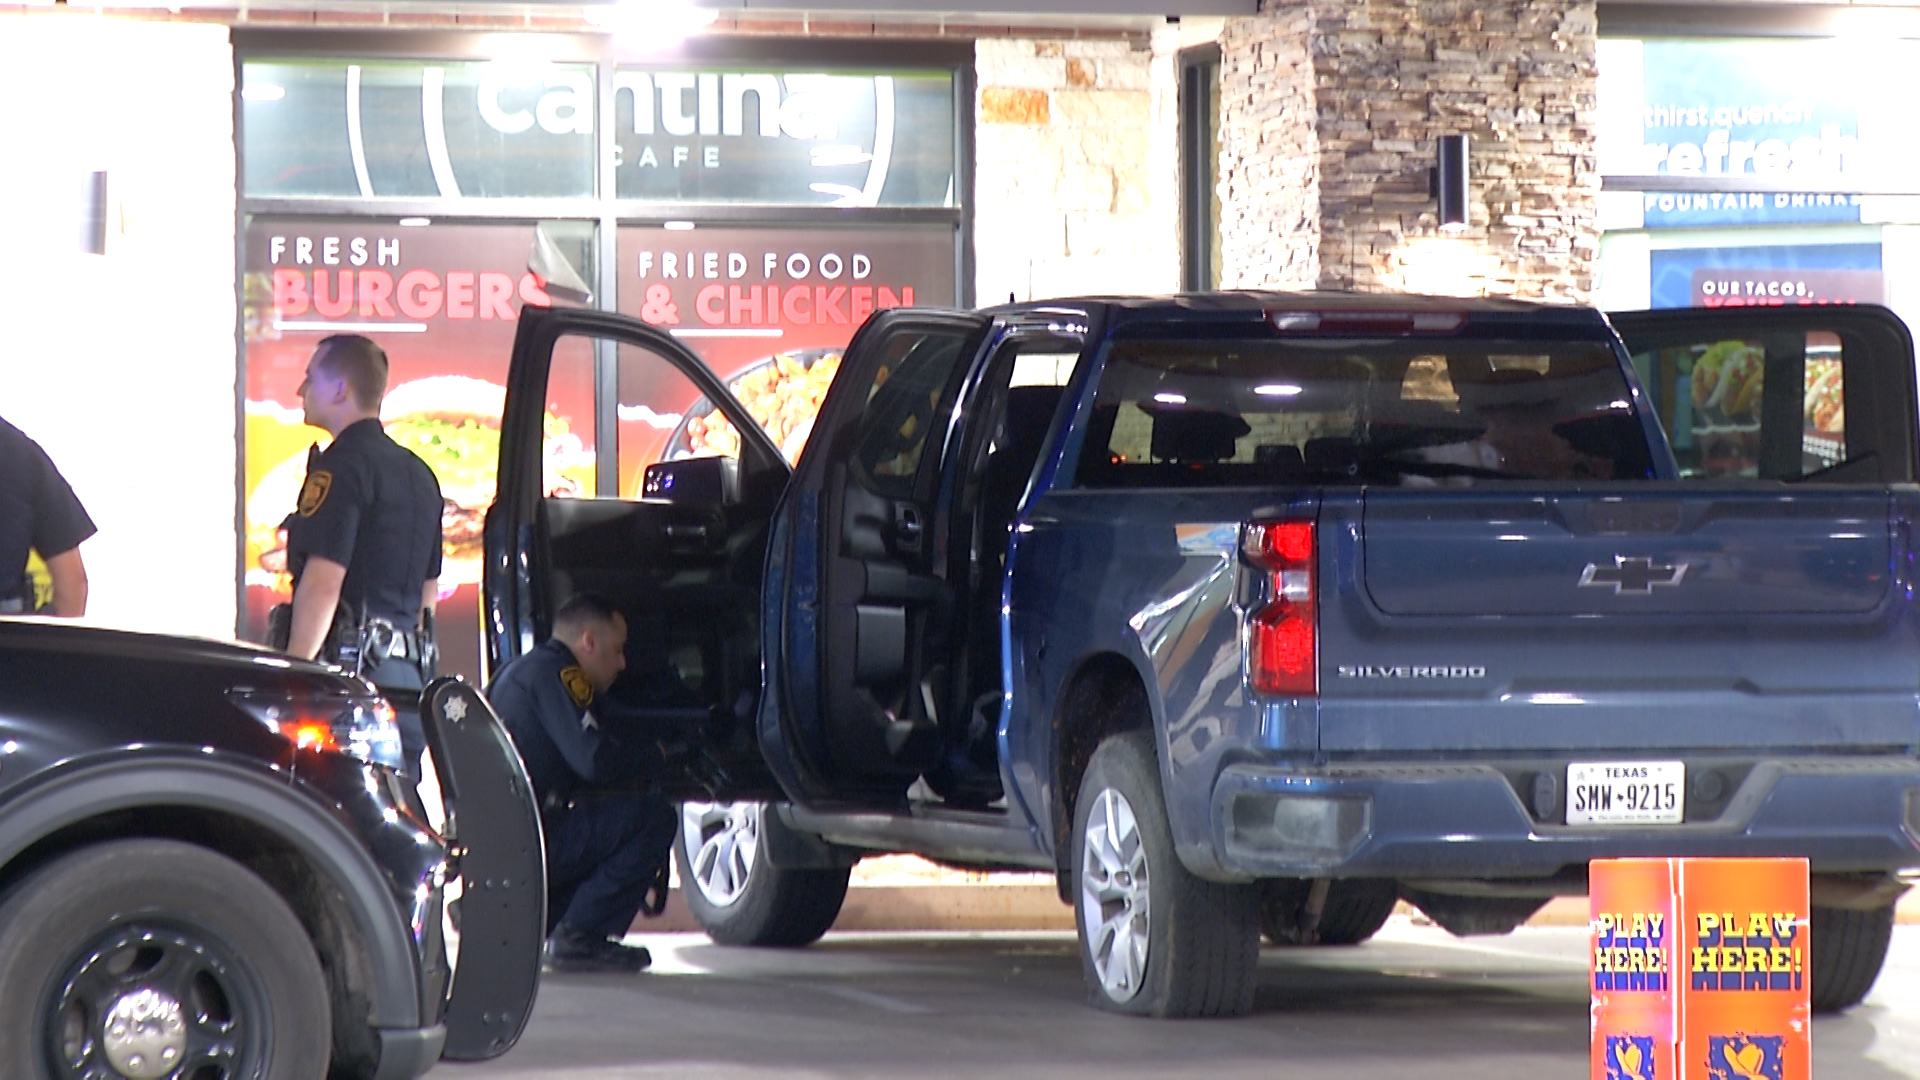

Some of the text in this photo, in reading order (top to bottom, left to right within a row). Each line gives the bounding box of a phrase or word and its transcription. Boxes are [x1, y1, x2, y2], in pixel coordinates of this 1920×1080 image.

[1645, 193, 1764, 212] FOUNTAIN
[270, 236, 400, 266] FRESH
[638, 252, 871, 280] FRIED FOOD
[272, 268, 552, 321] BURGERS
[1702, 280, 1814, 298] OUR TACOS,
[640, 284, 680, 326] &
[1338, 665, 1486, 678] SILVERADO
[1605, 767, 1649, 778] TEXAS
[1598, 912, 1663, 940] PLAY
[1697, 912, 1797, 940] PLAY
[1594, 946, 1668, 974] HERE!
[1691, 946, 1802, 974] HERE!
